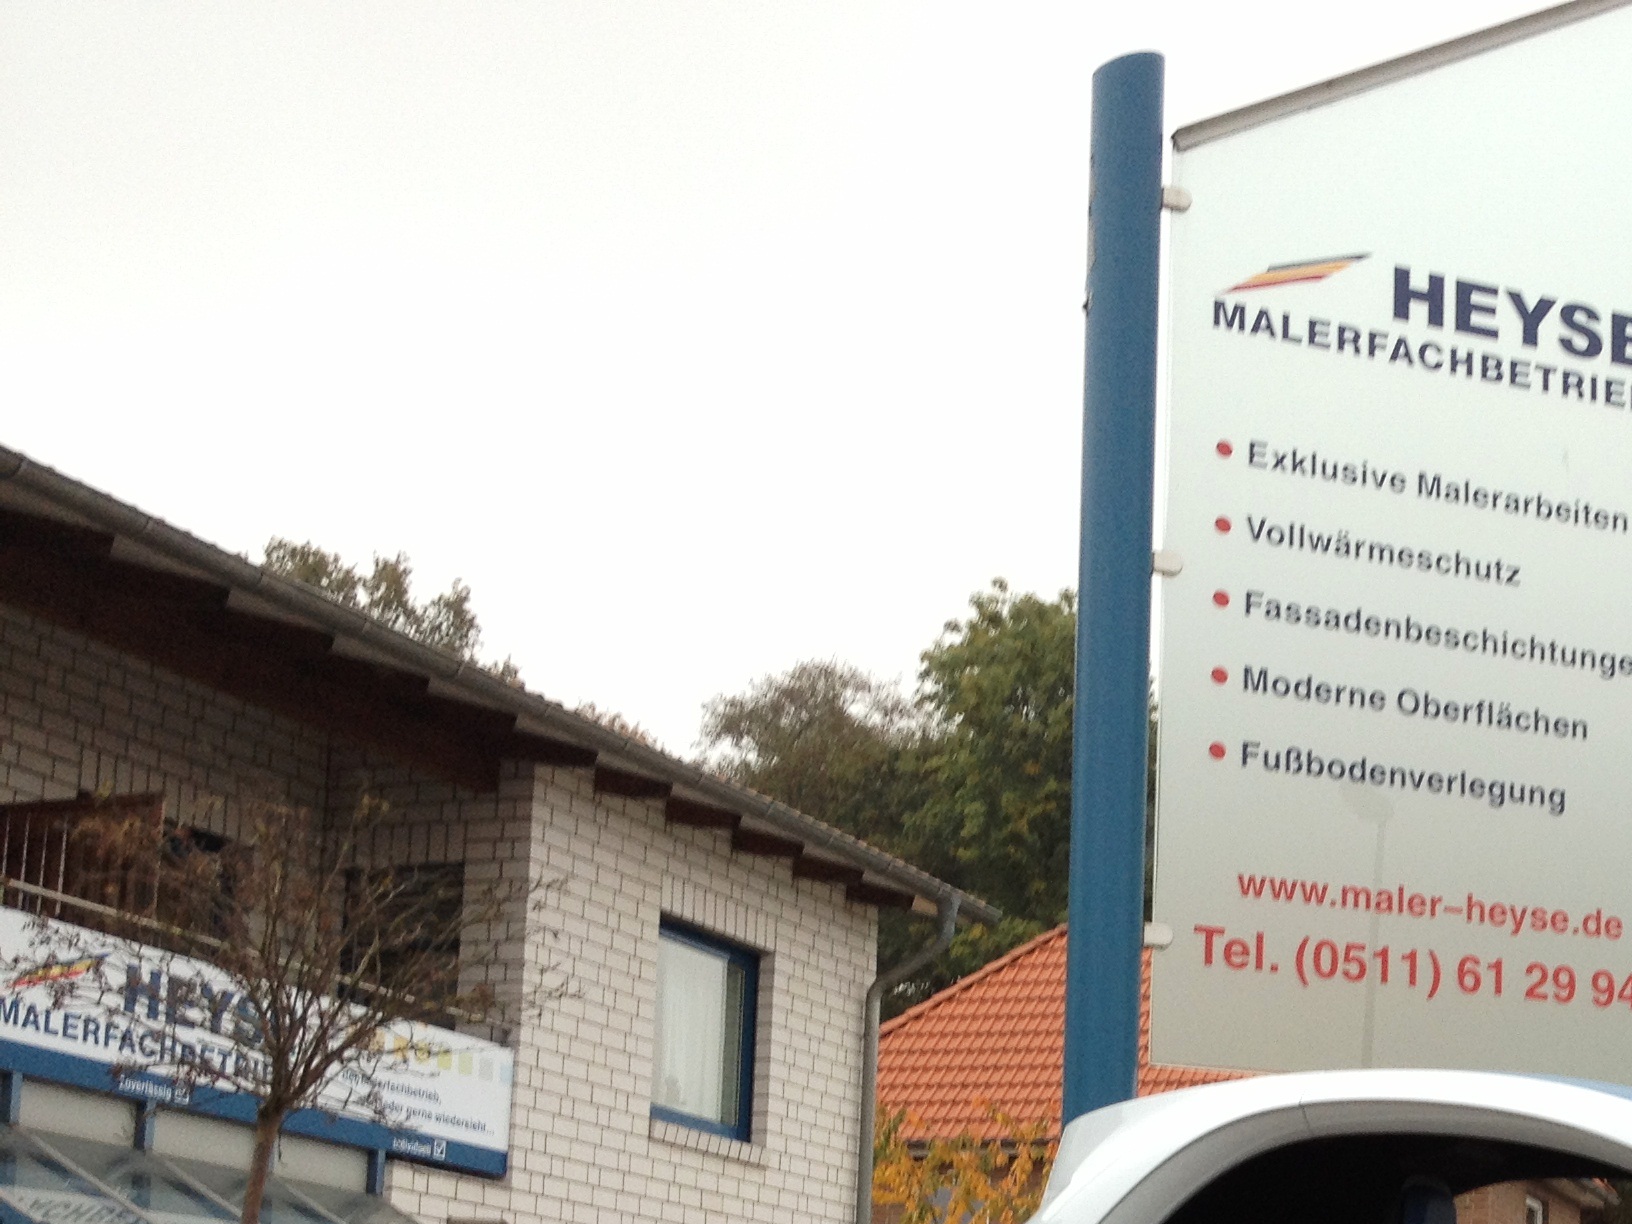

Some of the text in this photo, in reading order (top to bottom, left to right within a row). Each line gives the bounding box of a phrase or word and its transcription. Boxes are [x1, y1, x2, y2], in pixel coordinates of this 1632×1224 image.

[1247, 440, 1629, 534] Exklusive Malerarbeiten
[1246, 515, 1522, 587] Vollwärmeschutz
[1242, 665, 1589, 741] Moderne Oberflächen
[1240, 740, 1567, 815] Fußbodenverlegung
[1237, 872, 1624, 941] www.maler-heyse.de
[1193, 923, 1280, 973] Tel.
[1294, 935, 1442, 999] (0511)
[1456, 954, 1503, 997] 61
[1523, 961, 1577, 1004] 29
